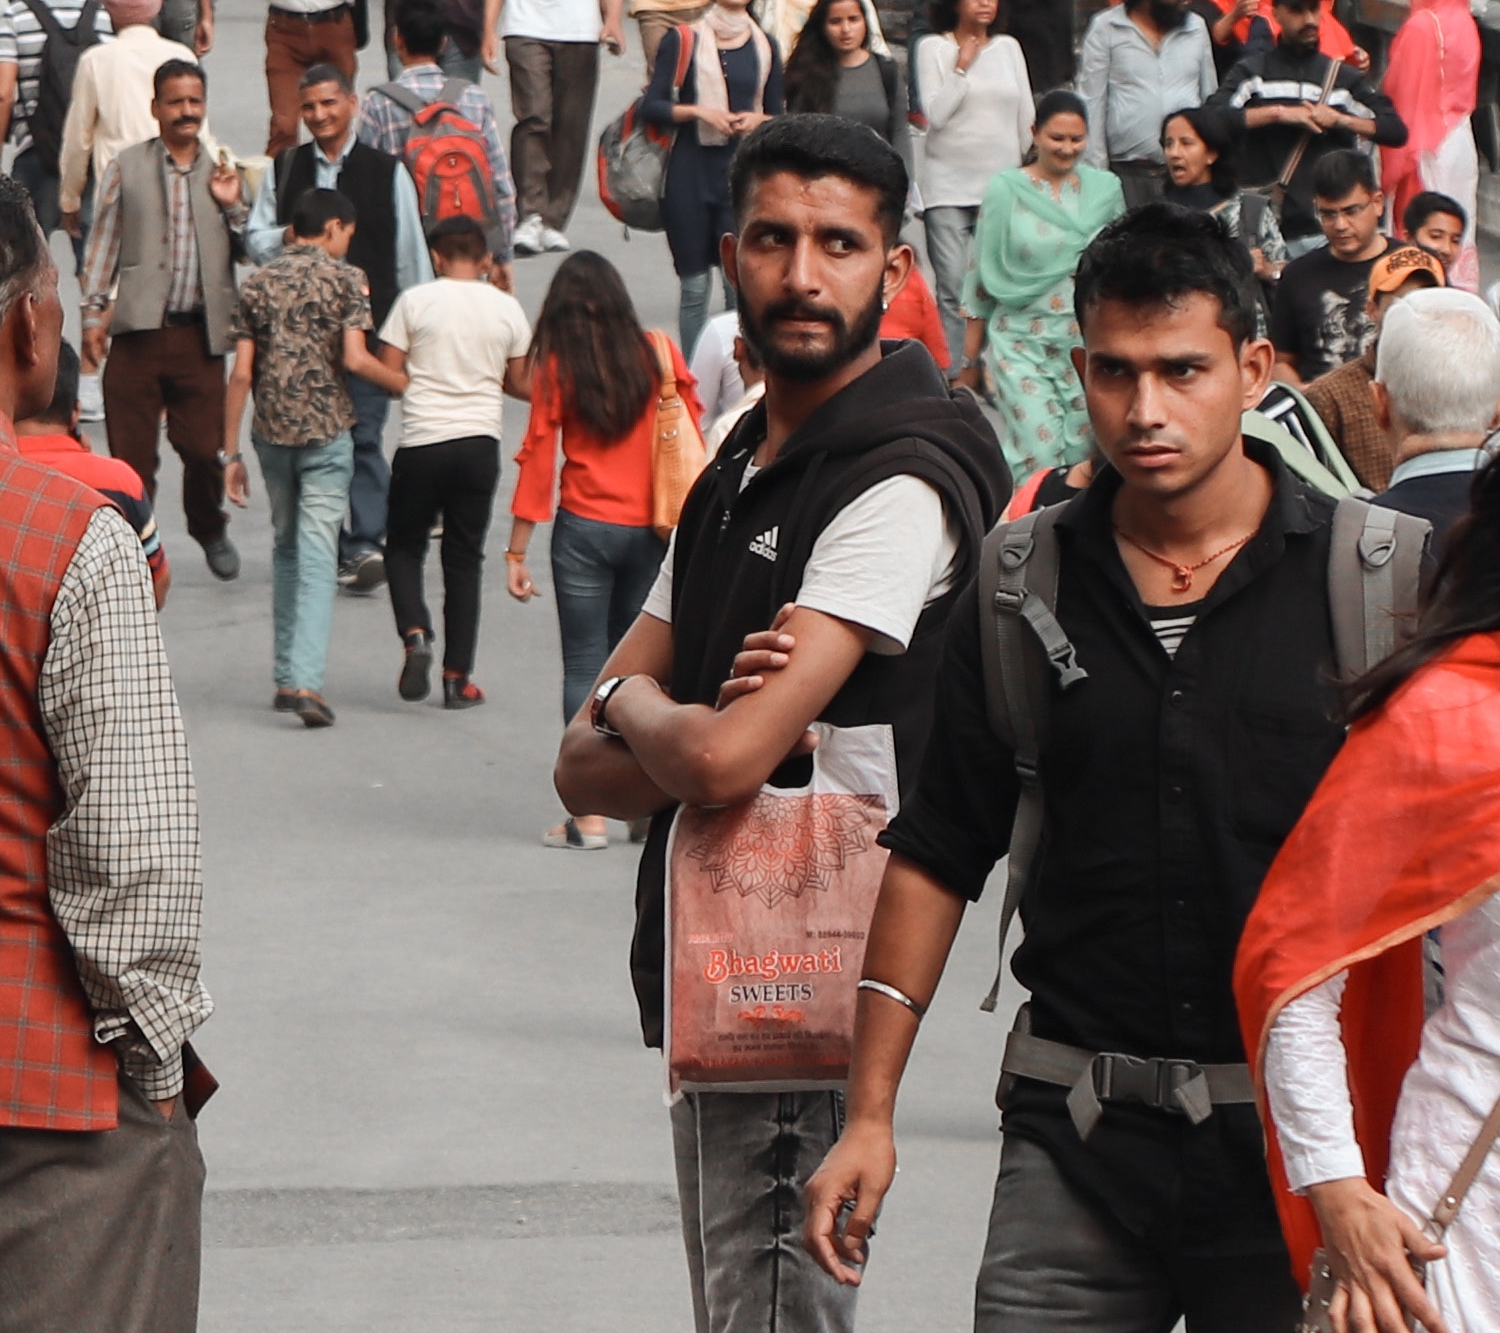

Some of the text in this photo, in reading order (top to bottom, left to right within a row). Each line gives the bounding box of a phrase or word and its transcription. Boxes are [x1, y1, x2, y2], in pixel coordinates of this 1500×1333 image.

[749, 541, 778, 562] adidas
[704, 945, 842, 983] Bhagwati
[730, 984, 813, 1003] SWEETS
